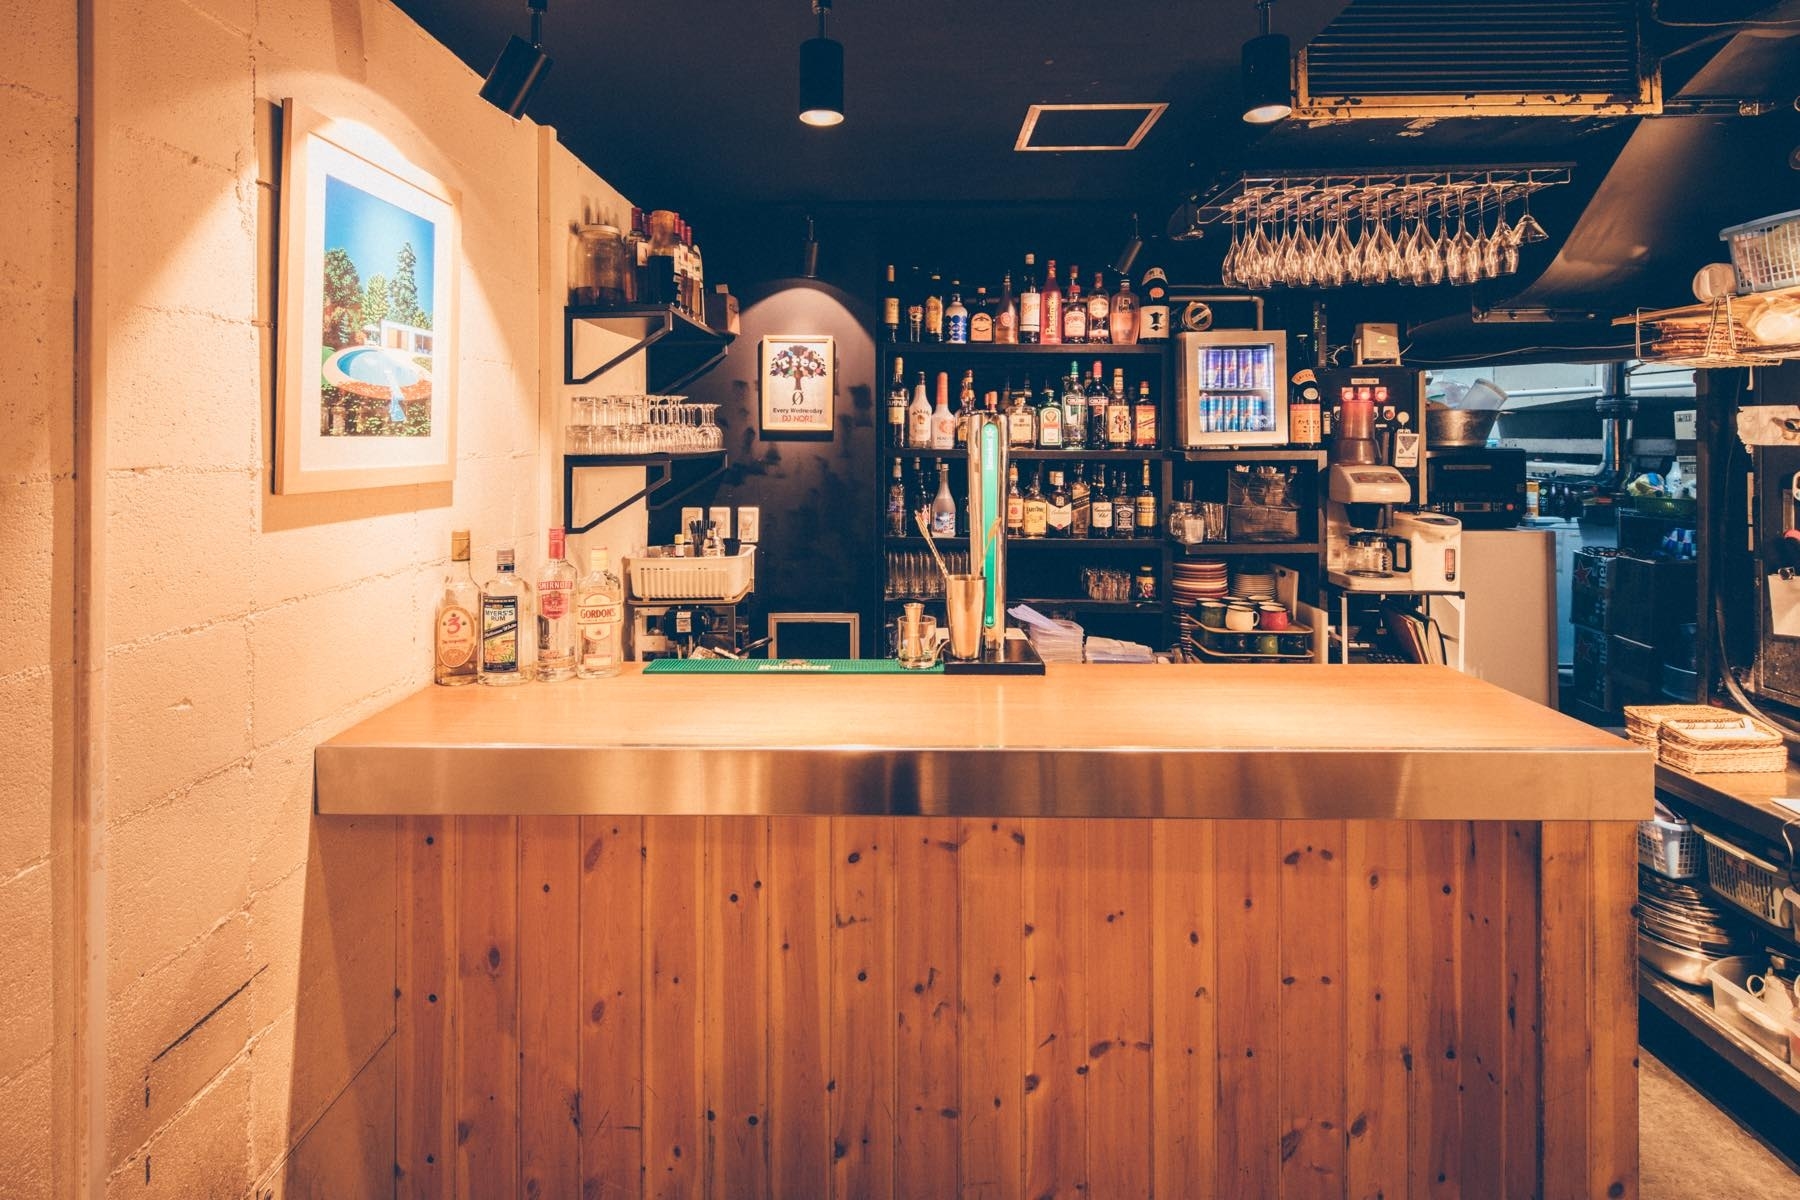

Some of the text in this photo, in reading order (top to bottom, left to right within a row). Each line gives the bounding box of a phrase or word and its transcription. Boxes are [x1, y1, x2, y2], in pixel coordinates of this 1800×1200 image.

[778, 356, 818, 371] Tree
[790, 407, 823, 415] Wednesday
[538, 581, 572, 590] SMIRNOFF
[446, 616, 461, 634] 3
